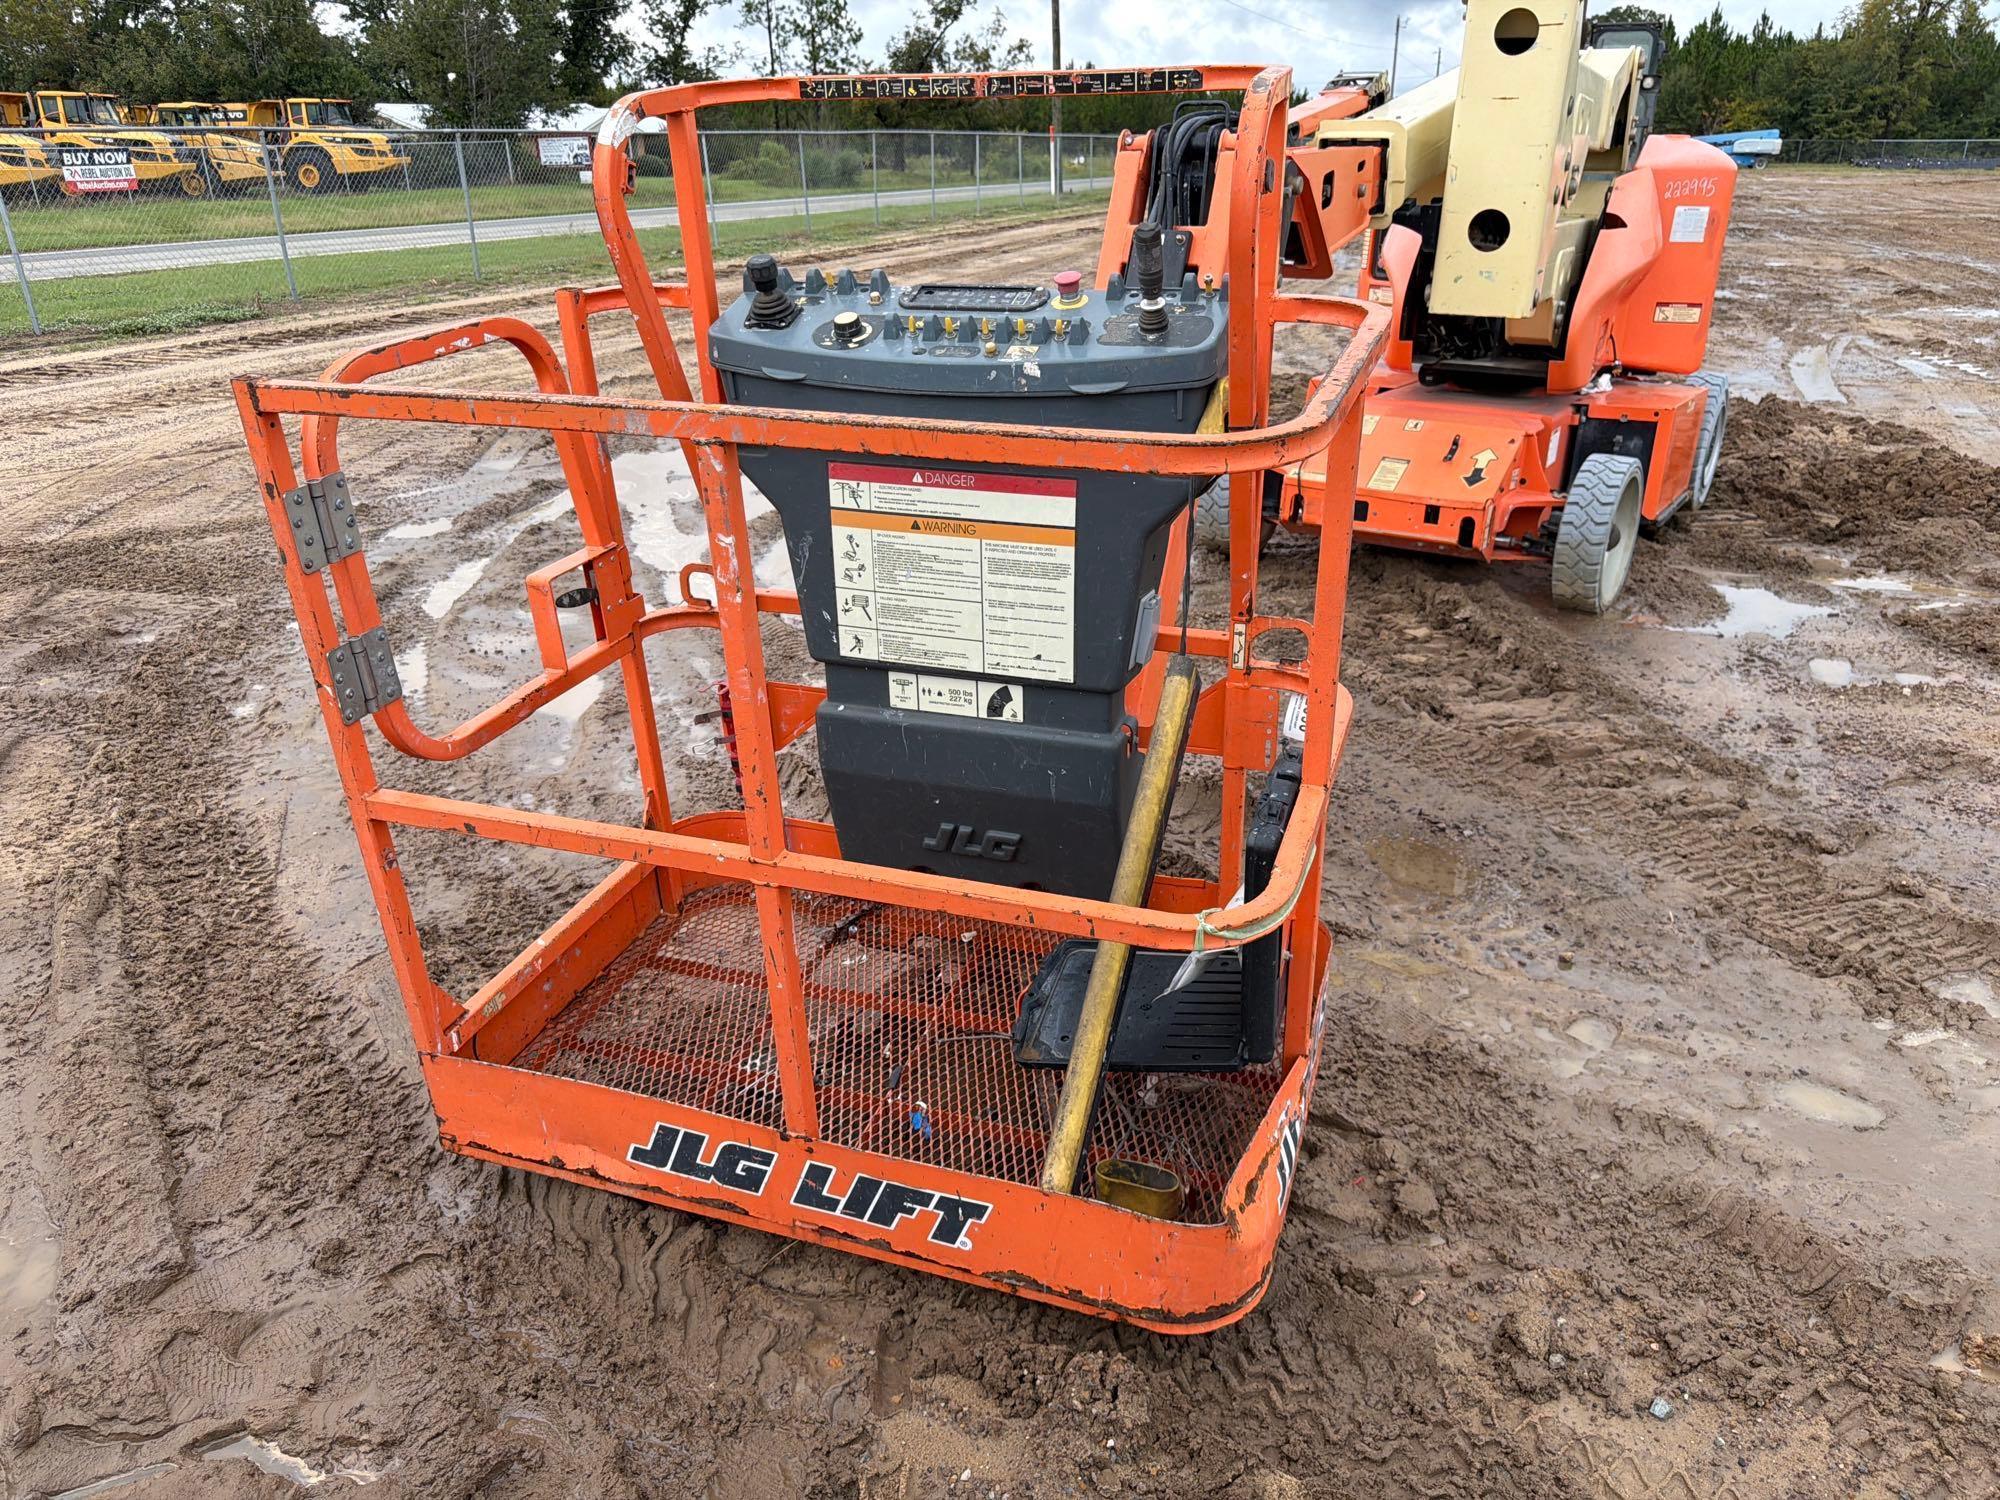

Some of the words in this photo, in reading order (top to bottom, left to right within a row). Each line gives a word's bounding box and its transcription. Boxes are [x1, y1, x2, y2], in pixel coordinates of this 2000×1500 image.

[62, 152, 89, 165] BUY
[93, 151, 127, 164] NOW
[81, 167, 99, 178] REBEL
[100, 167, 123, 178] AUCTION
[77, 181, 128, 190] RebelAuction.com
[1664, 176, 1718, 200] 222995
[925, 472, 975, 487] DANGER
[922, 520, 977, 535] WARNING
[963, 697, 973, 705] kg
[923, 822, 1021, 861] JLG
[626, 1121, 779, 1196] JLG
[789, 1158, 993, 1249] LIFT
